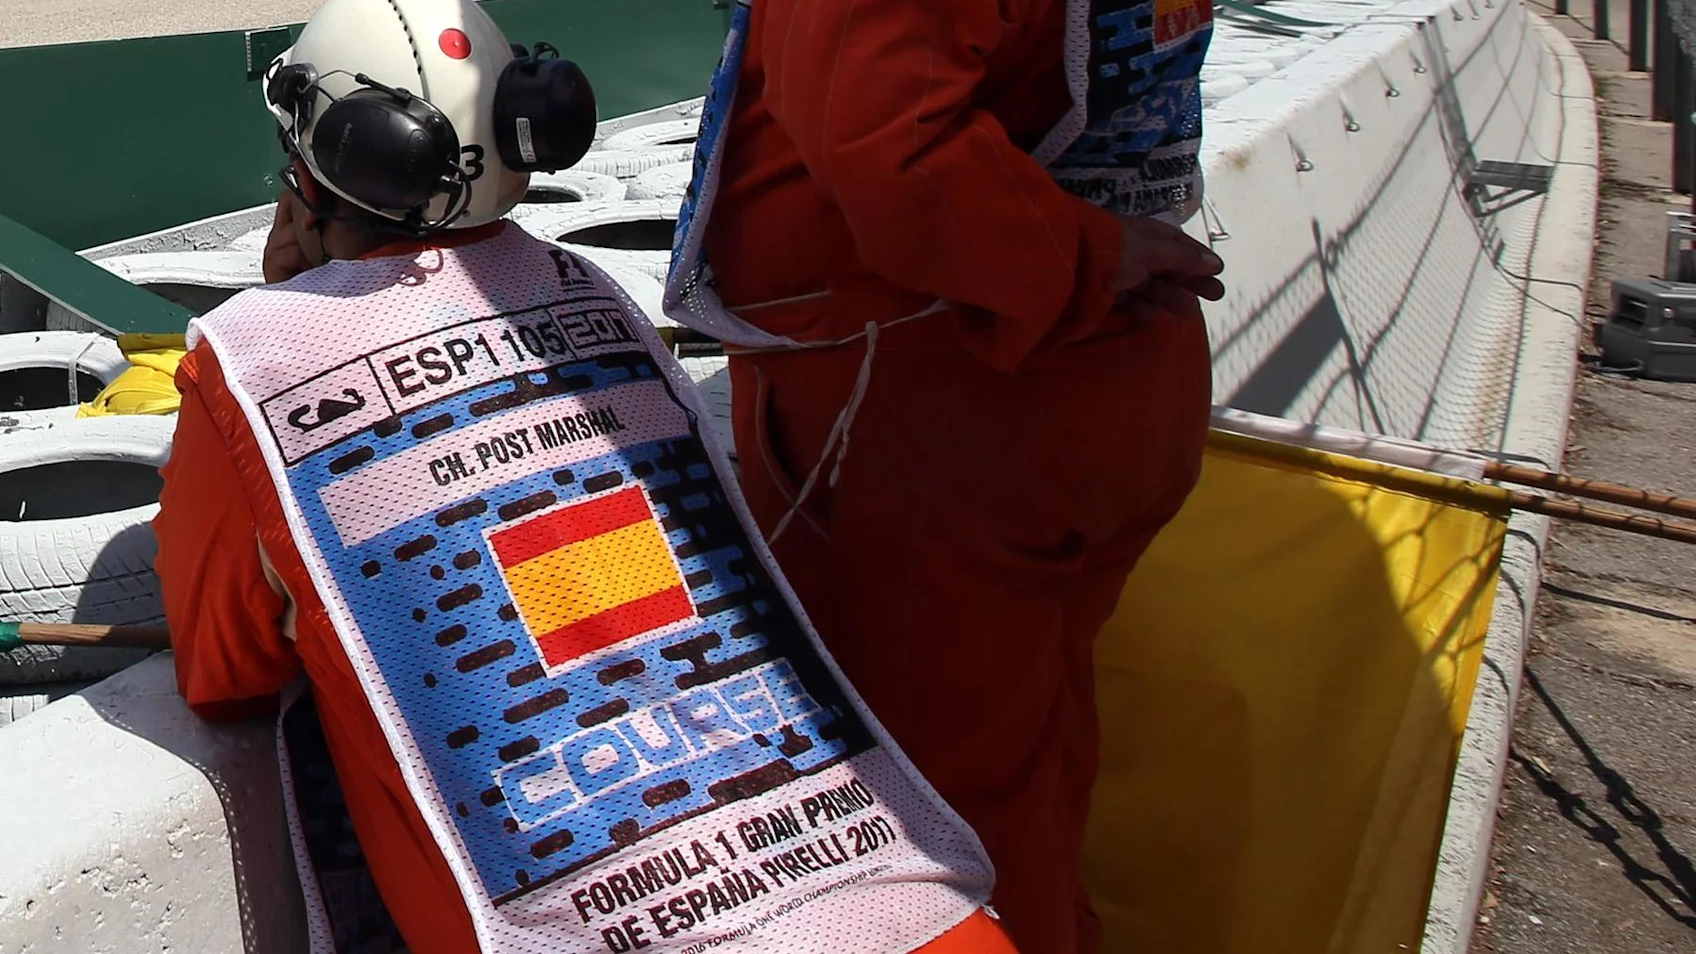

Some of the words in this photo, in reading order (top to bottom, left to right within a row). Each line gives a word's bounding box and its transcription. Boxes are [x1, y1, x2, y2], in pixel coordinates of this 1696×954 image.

[385, 333, 501, 397] ESP1
[501, 322, 566, 362] 105
[429, 454, 475, 486] CH.
[475, 430, 535, 473] POST
[534, 406, 625, 451] MARSHAL
[491, 659, 822, 830] COURSE
[571, 838, 718, 923] FORMULA
[715, 831, 738, 861] 1
[736, 803, 804, 852] GRAN
[801, 779, 874, 828] PREMIO
[601, 915, 650, 954] DE
[648, 866, 769, 938] ESPAÑA
[760, 832, 850, 889] PIRELLI
[847, 815, 896, 857] 2017
[707, 922, 757, 948] FORMULA
[756, 914, 776, 929] ONE
[775, 898, 803, 919] WORLD
[803, 871, 868, 904] CHAMPIONSHIP
